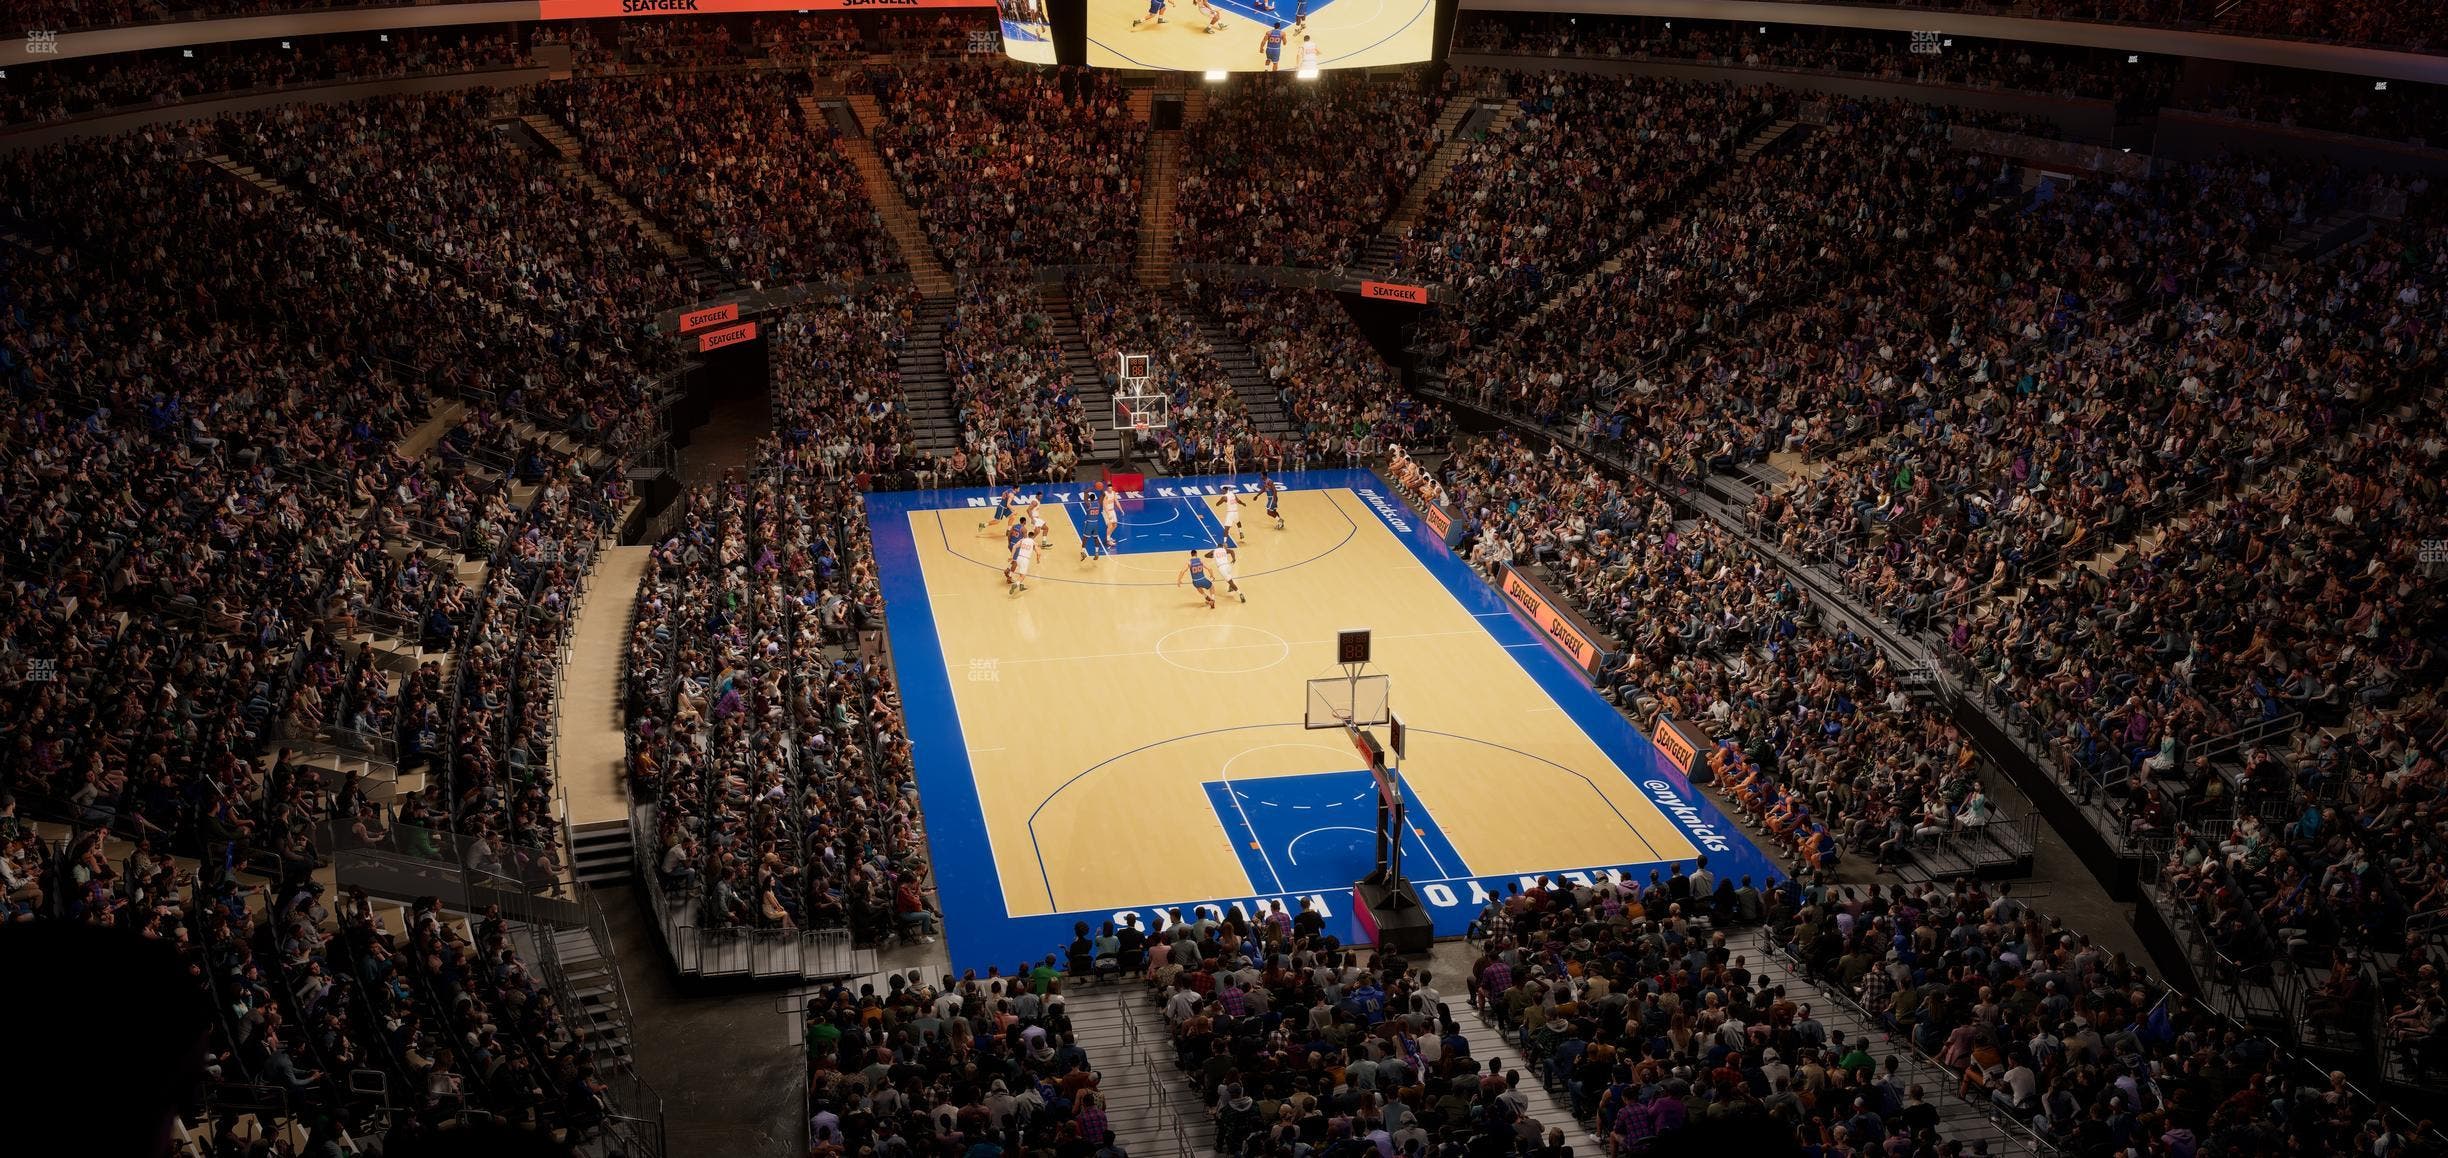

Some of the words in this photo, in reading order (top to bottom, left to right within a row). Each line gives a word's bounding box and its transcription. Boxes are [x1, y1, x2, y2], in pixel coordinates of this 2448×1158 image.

[622, 0, 698, 13] SEATGEEK
[1373, 286, 1416, 300] SEATGEEK
[690, 309, 729, 327] SEATGEEK
[708, 328, 746, 347] SEATGEEK
[1053, 491, 1145, 502] YOK
[1510, 580, 1540, 618] SEATGEEK
[1550, 618, 1584, 659] SEATGEEK
[1657, 727, 1692, 770] SEATGEEK
[1643, 780, 1730, 852] @nyknicks
